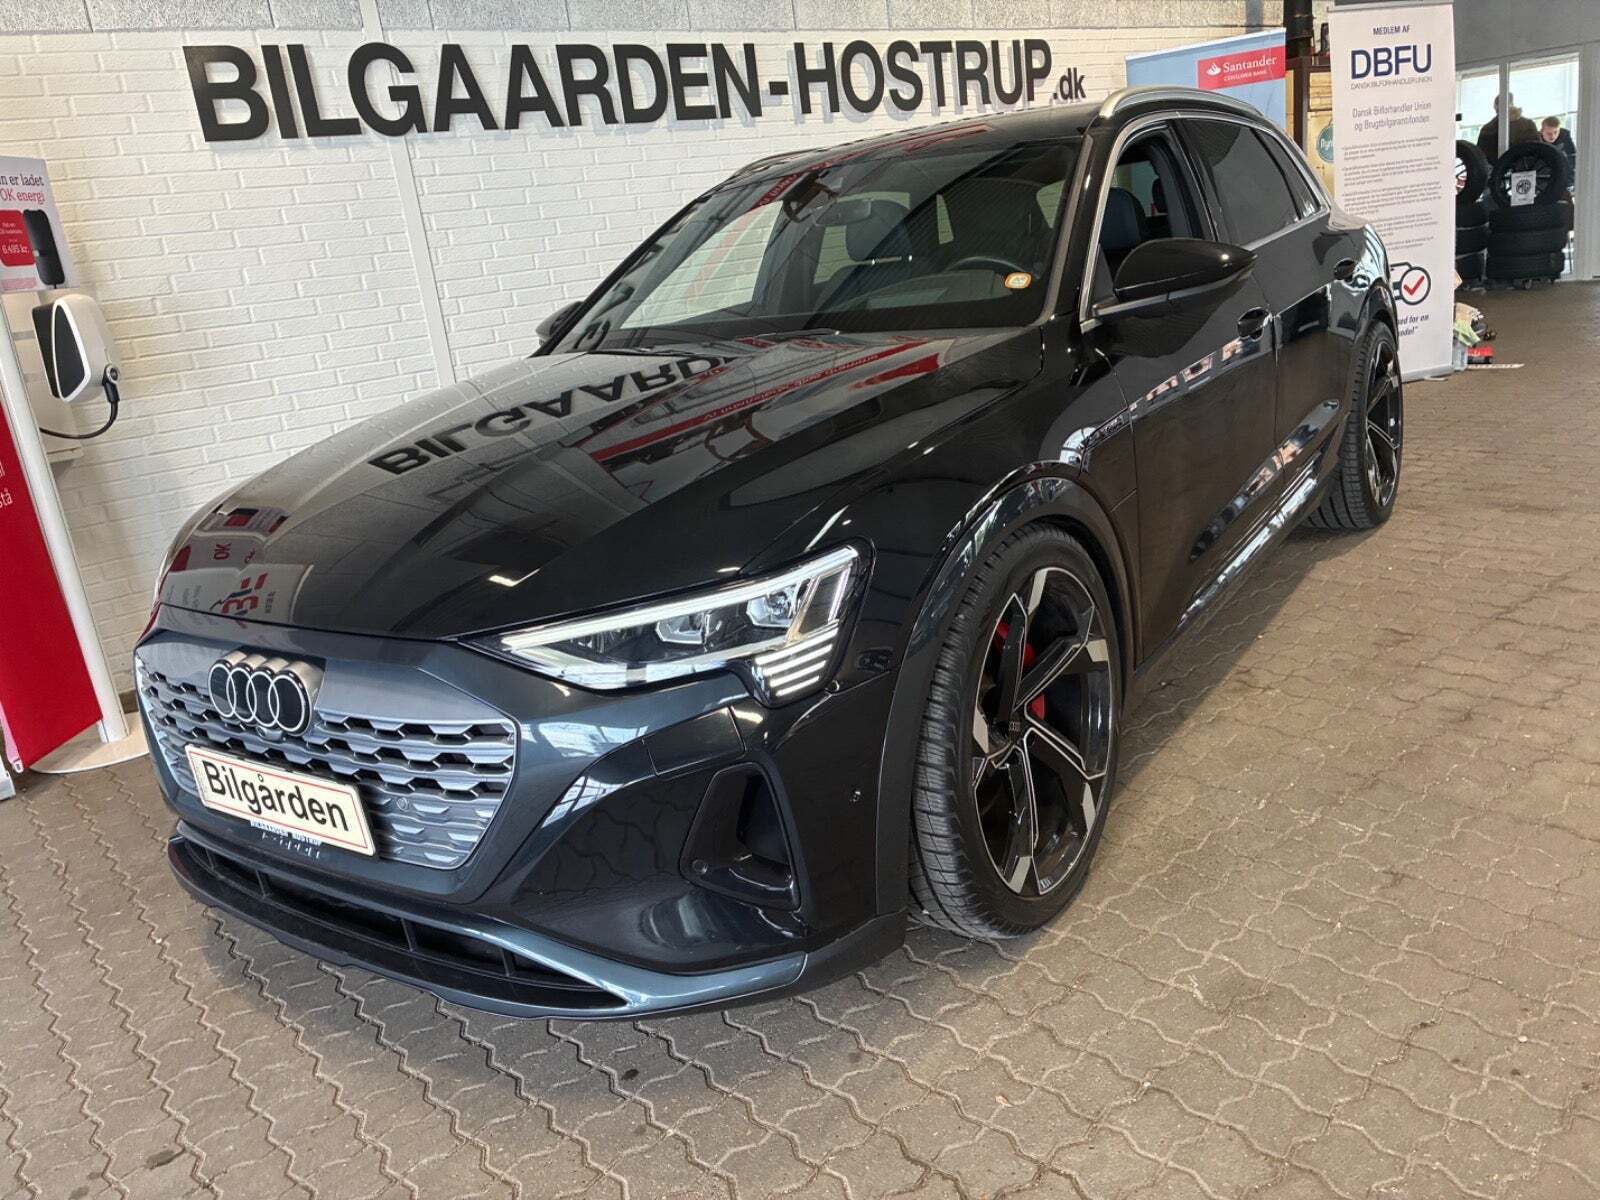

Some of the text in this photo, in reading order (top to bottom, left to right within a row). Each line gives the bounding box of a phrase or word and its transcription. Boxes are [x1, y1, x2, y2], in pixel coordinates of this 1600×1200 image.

[1373, 25, 1410, 35] MEDLEM AF
[1223, 55, 1277, 73] Santander
[1351, 43, 1432, 79] DBFU
[1352, 107, 1372, 118] Dansk
[1414, 102, 1432, 111] Union
[9, 175, 19, 185] er
[20, 173, 44, 186] ladet
[202, 759, 349, 832] Bilgården
